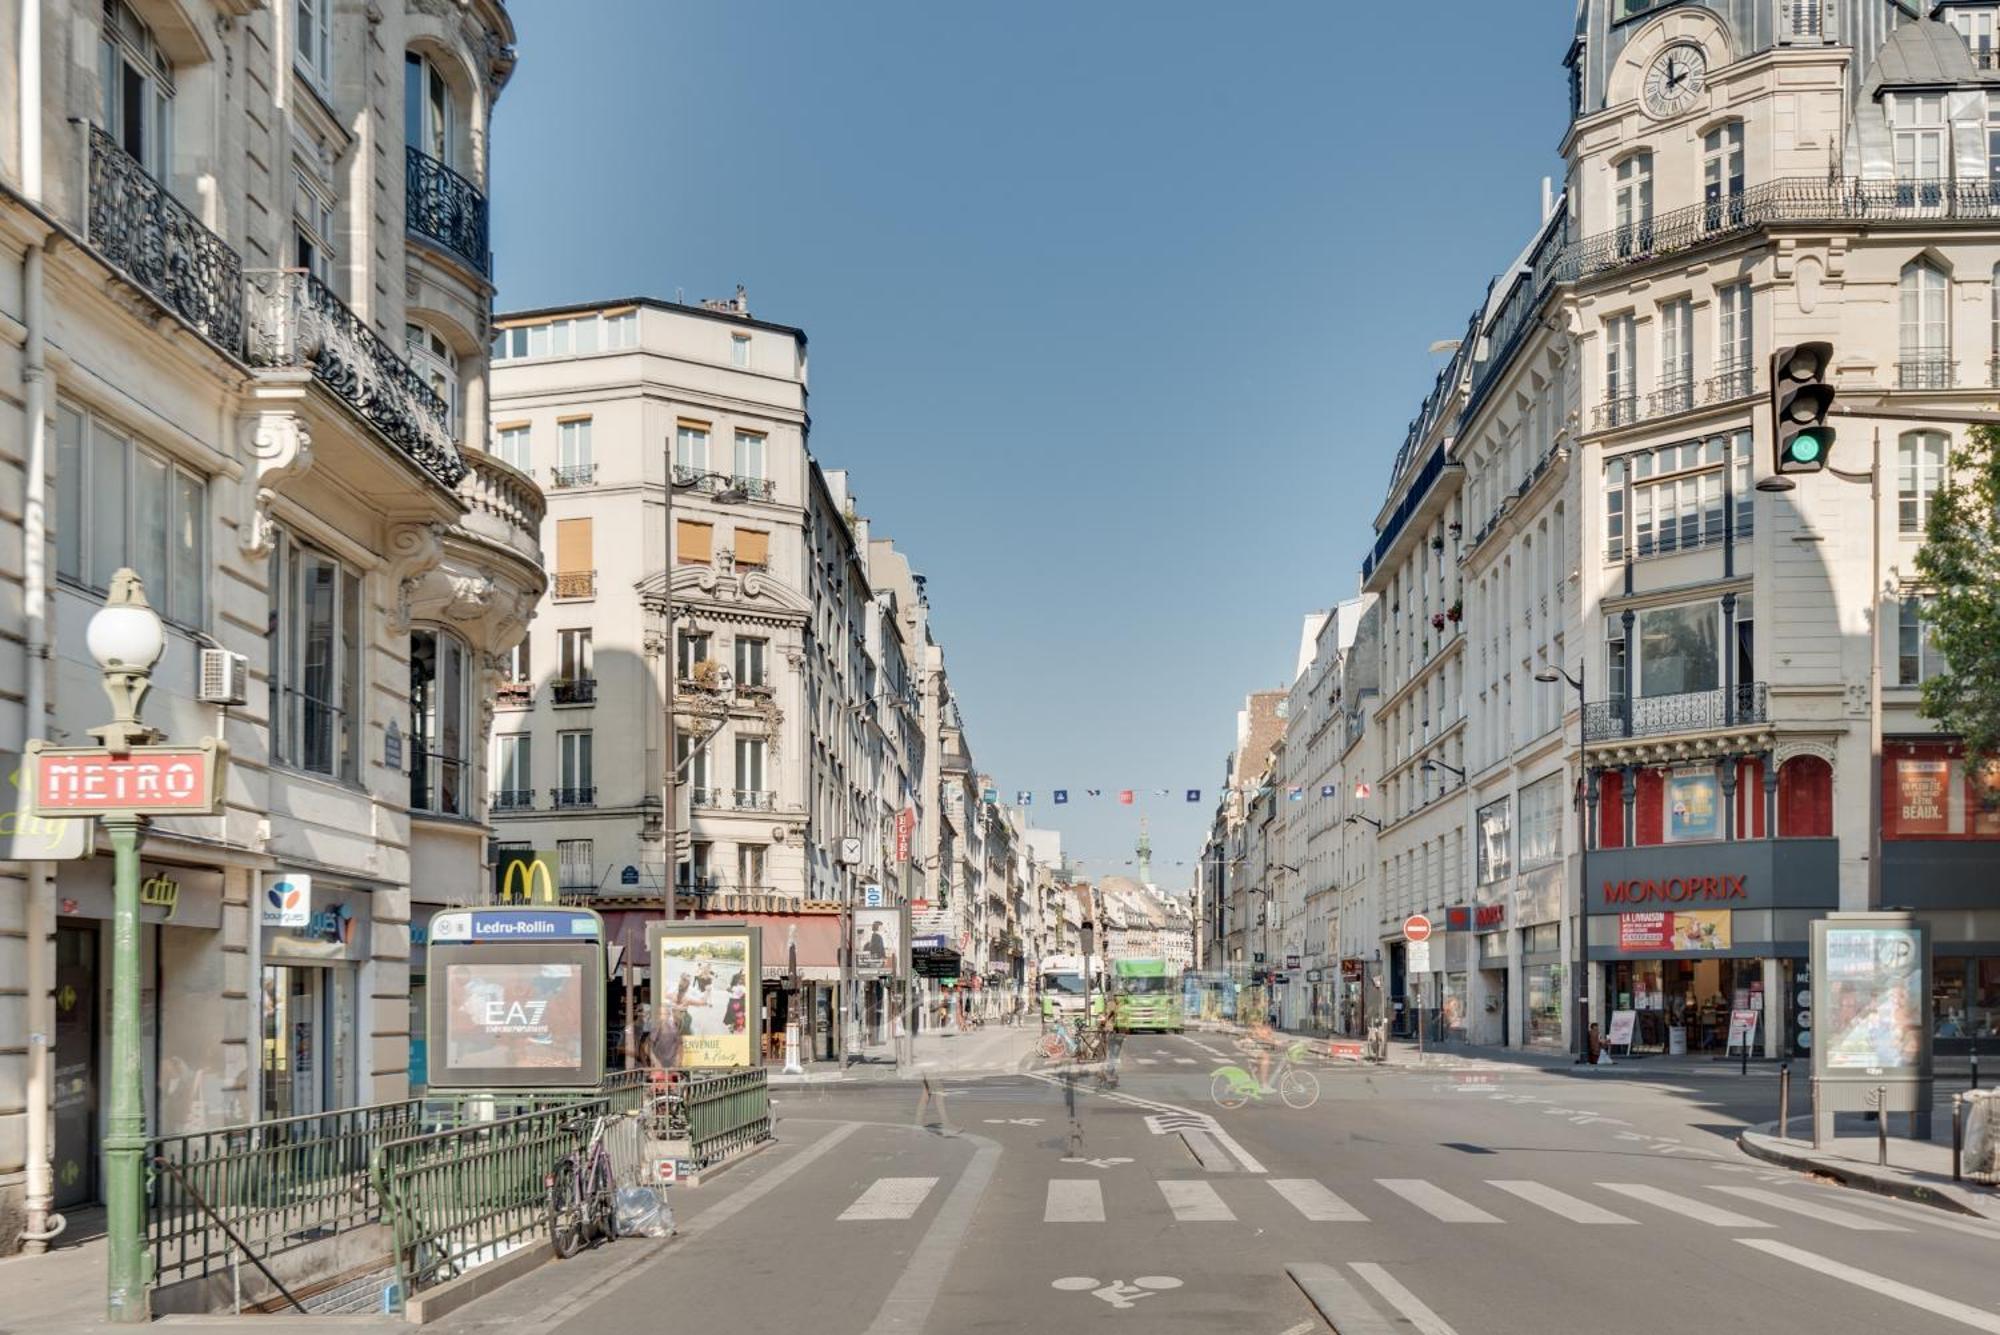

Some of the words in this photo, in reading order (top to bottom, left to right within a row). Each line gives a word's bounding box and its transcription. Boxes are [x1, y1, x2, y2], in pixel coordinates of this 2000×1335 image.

[50, 763, 195, 799] METRO
[1903, 805, 1943, 820] BEAUX.
[141, 872, 180, 921] city
[867, 887, 880, 907] HOP
[1603, 873, 1748, 905] MONOPRIX
[700, 894, 801, 913] FAUBOURG
[476, 921, 555, 935] Ledru-Rollin
[486, 1000, 548, 1025] EA7
[683, 1039, 720, 1049] ENVENUE
